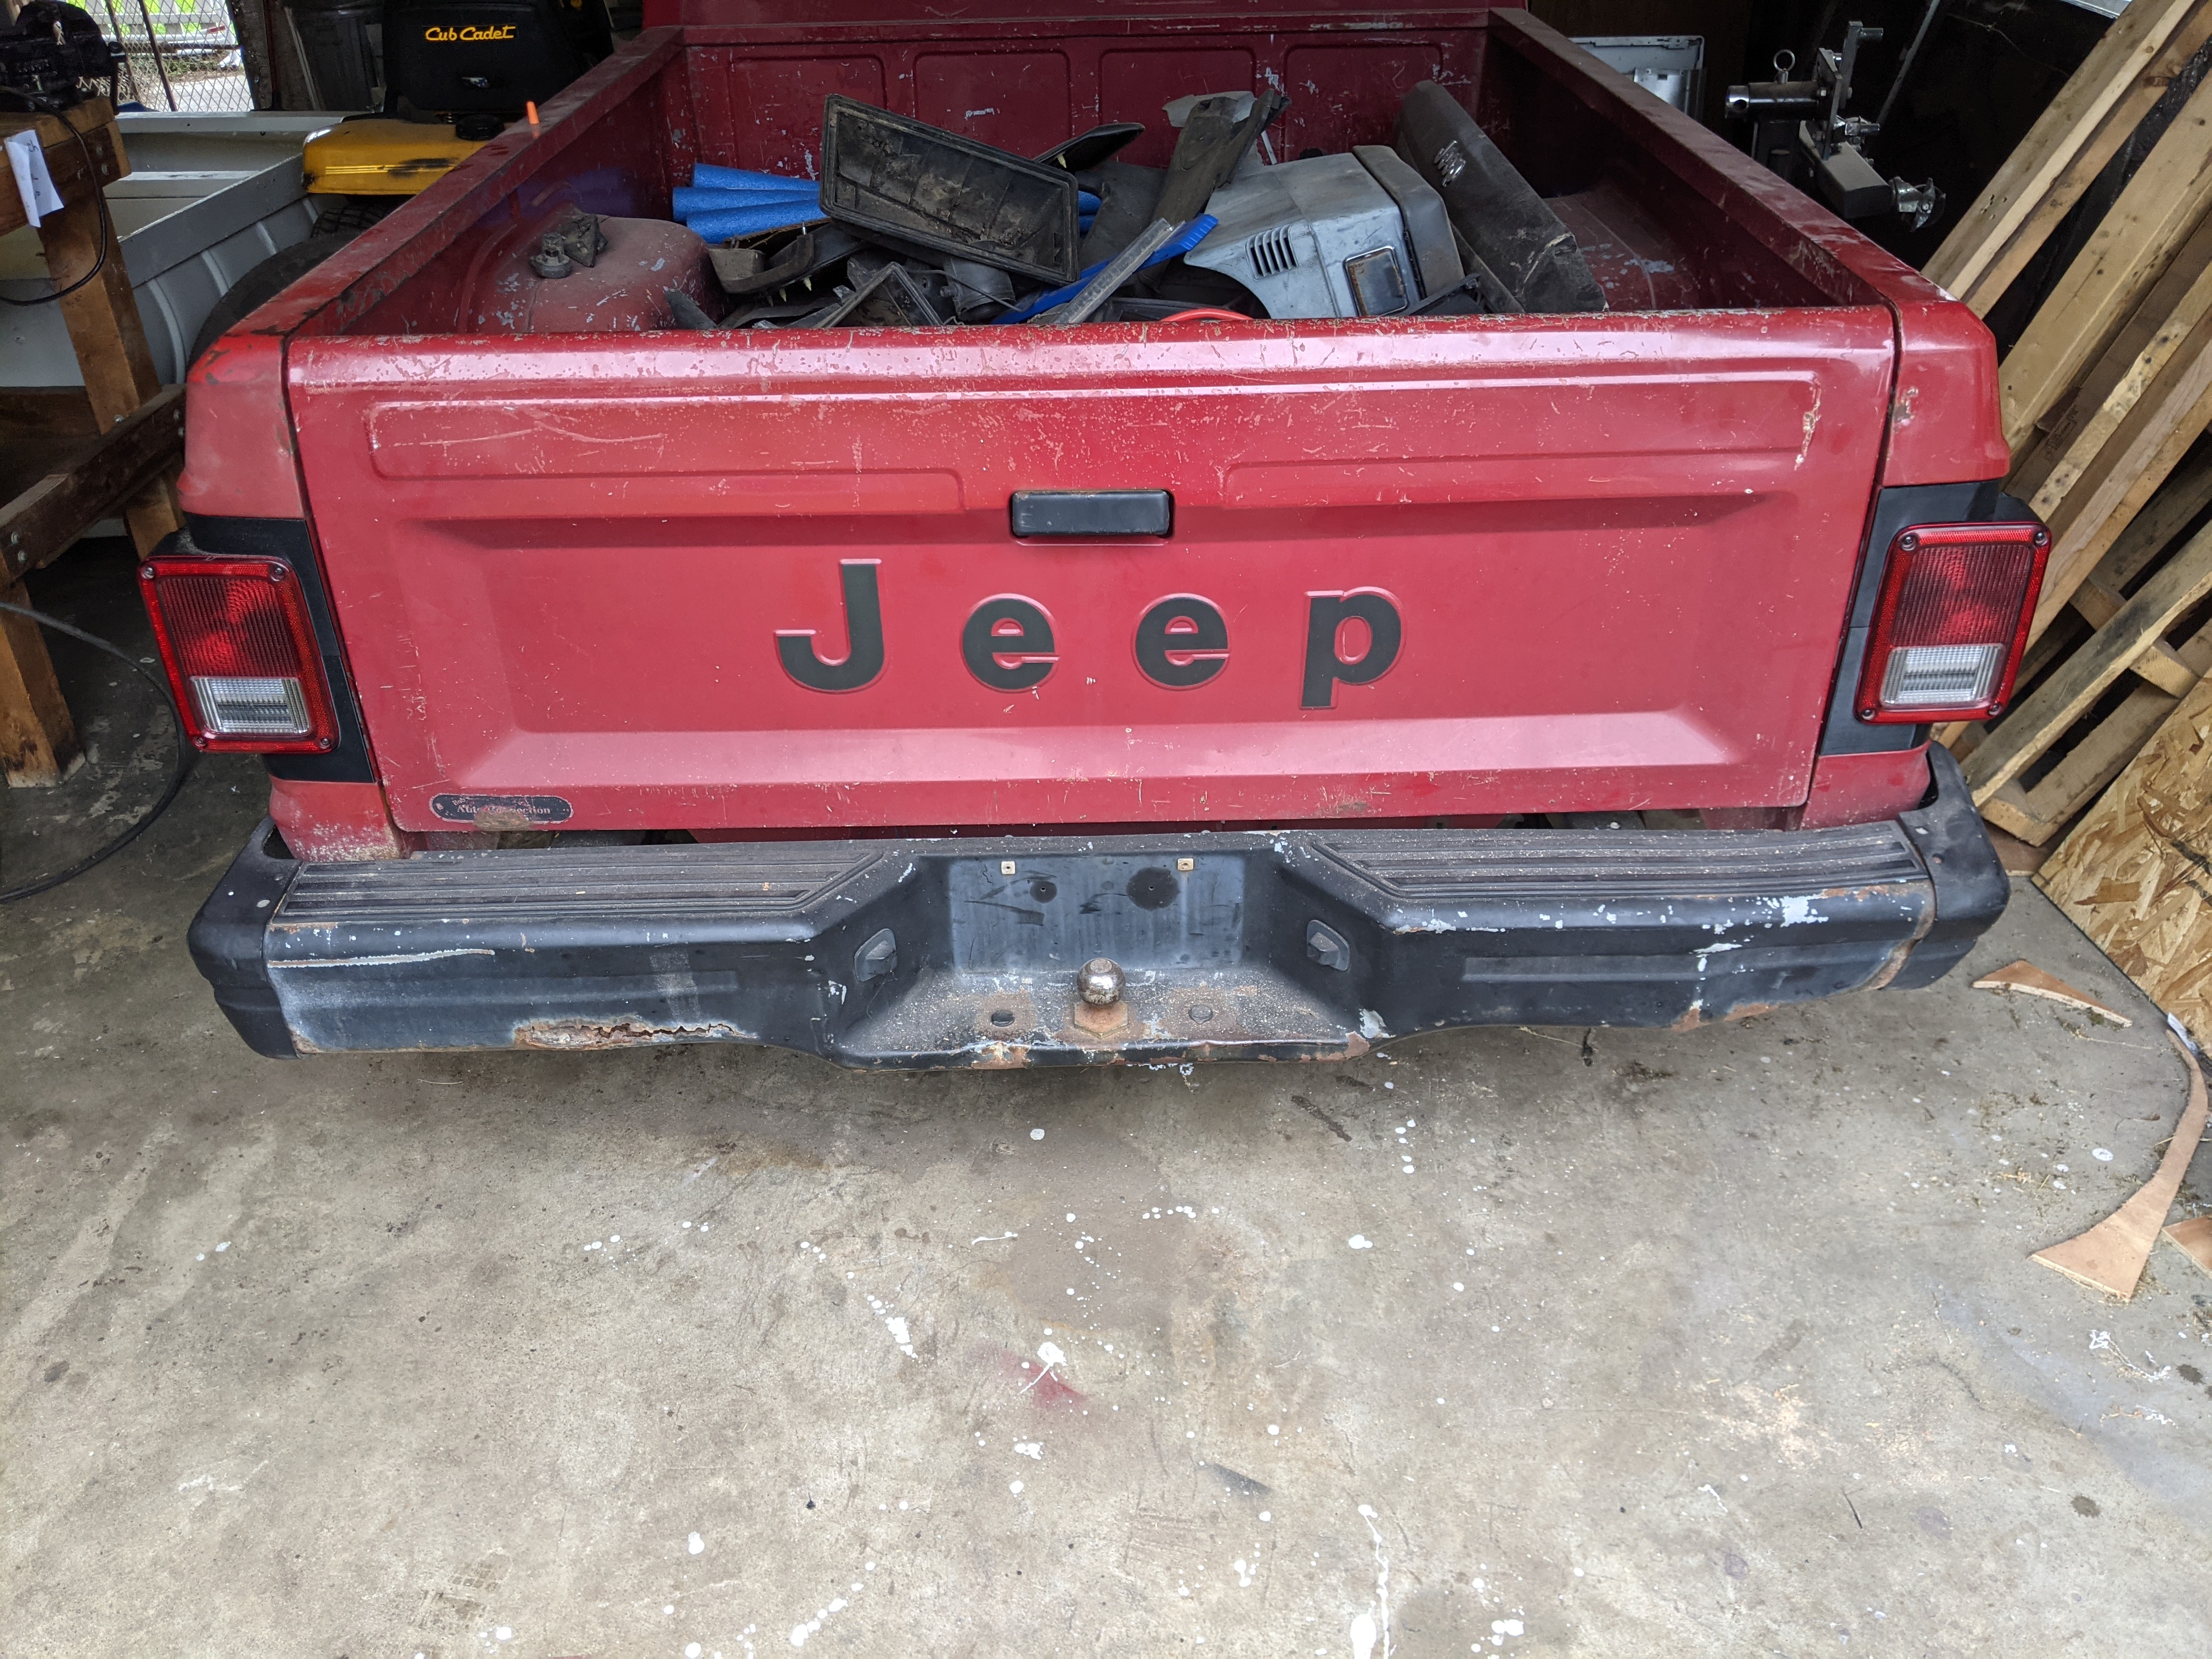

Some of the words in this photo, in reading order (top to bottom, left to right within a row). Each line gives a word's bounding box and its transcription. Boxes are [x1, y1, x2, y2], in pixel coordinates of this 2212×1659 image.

[425, 27, 458, 41] Cub
[460, 25, 516, 41] Cadet
[775, 558, 1406, 710] Jeep
[488, 805, 551, 815] Coection
